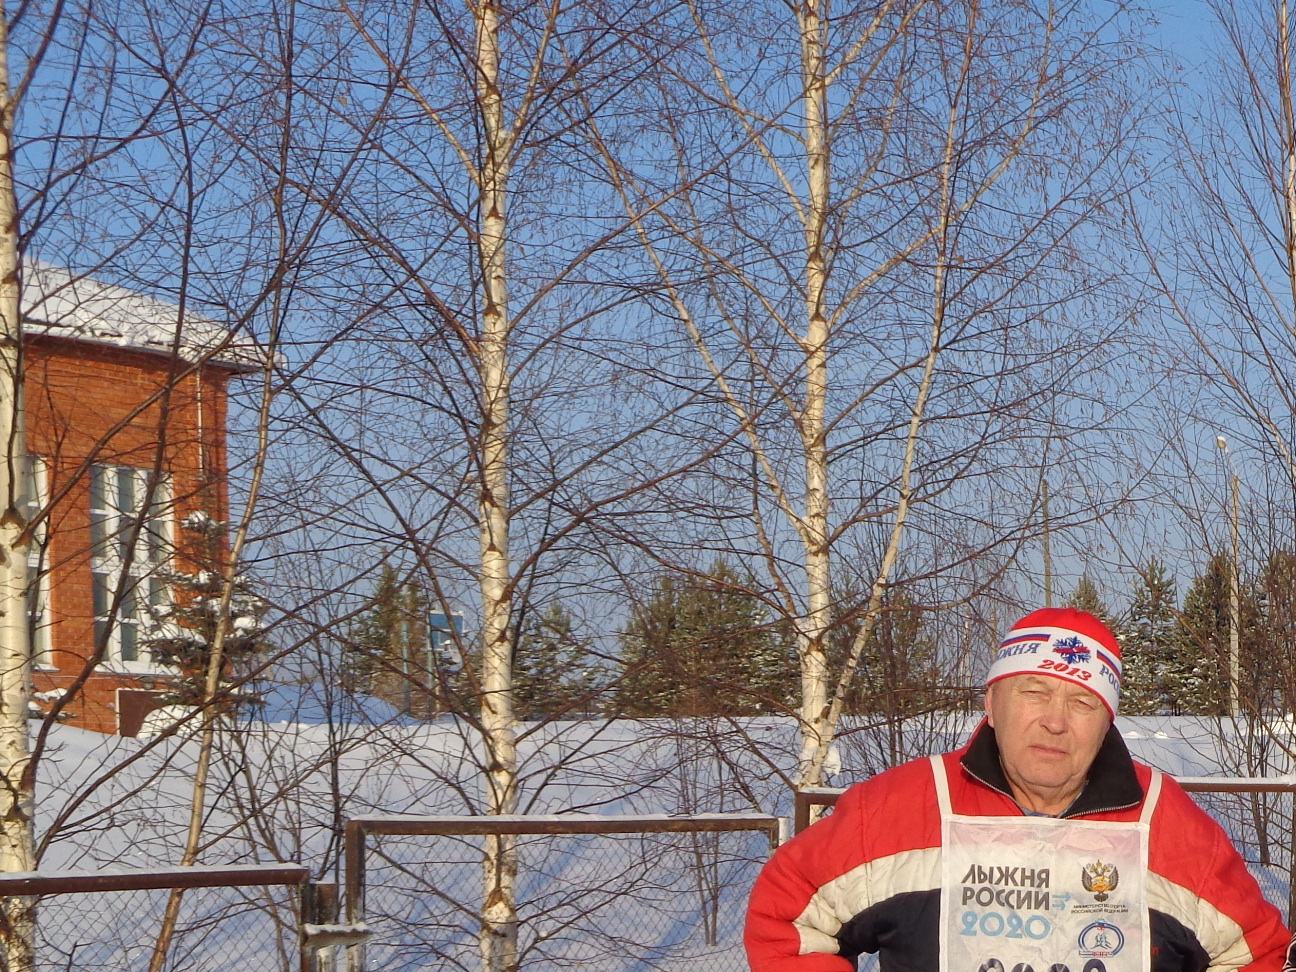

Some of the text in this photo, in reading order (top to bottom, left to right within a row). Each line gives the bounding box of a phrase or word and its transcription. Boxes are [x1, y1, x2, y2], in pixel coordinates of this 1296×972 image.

[996, 643, 1041, 660] ЖНЯ
[1037, 659, 1092, 681] 2013
[960, 864, 1050, 889] ЛЫЖНЯ
[961, 887, 1050, 911] РОССИИ
[959, 911, 1051, 940] 2020
